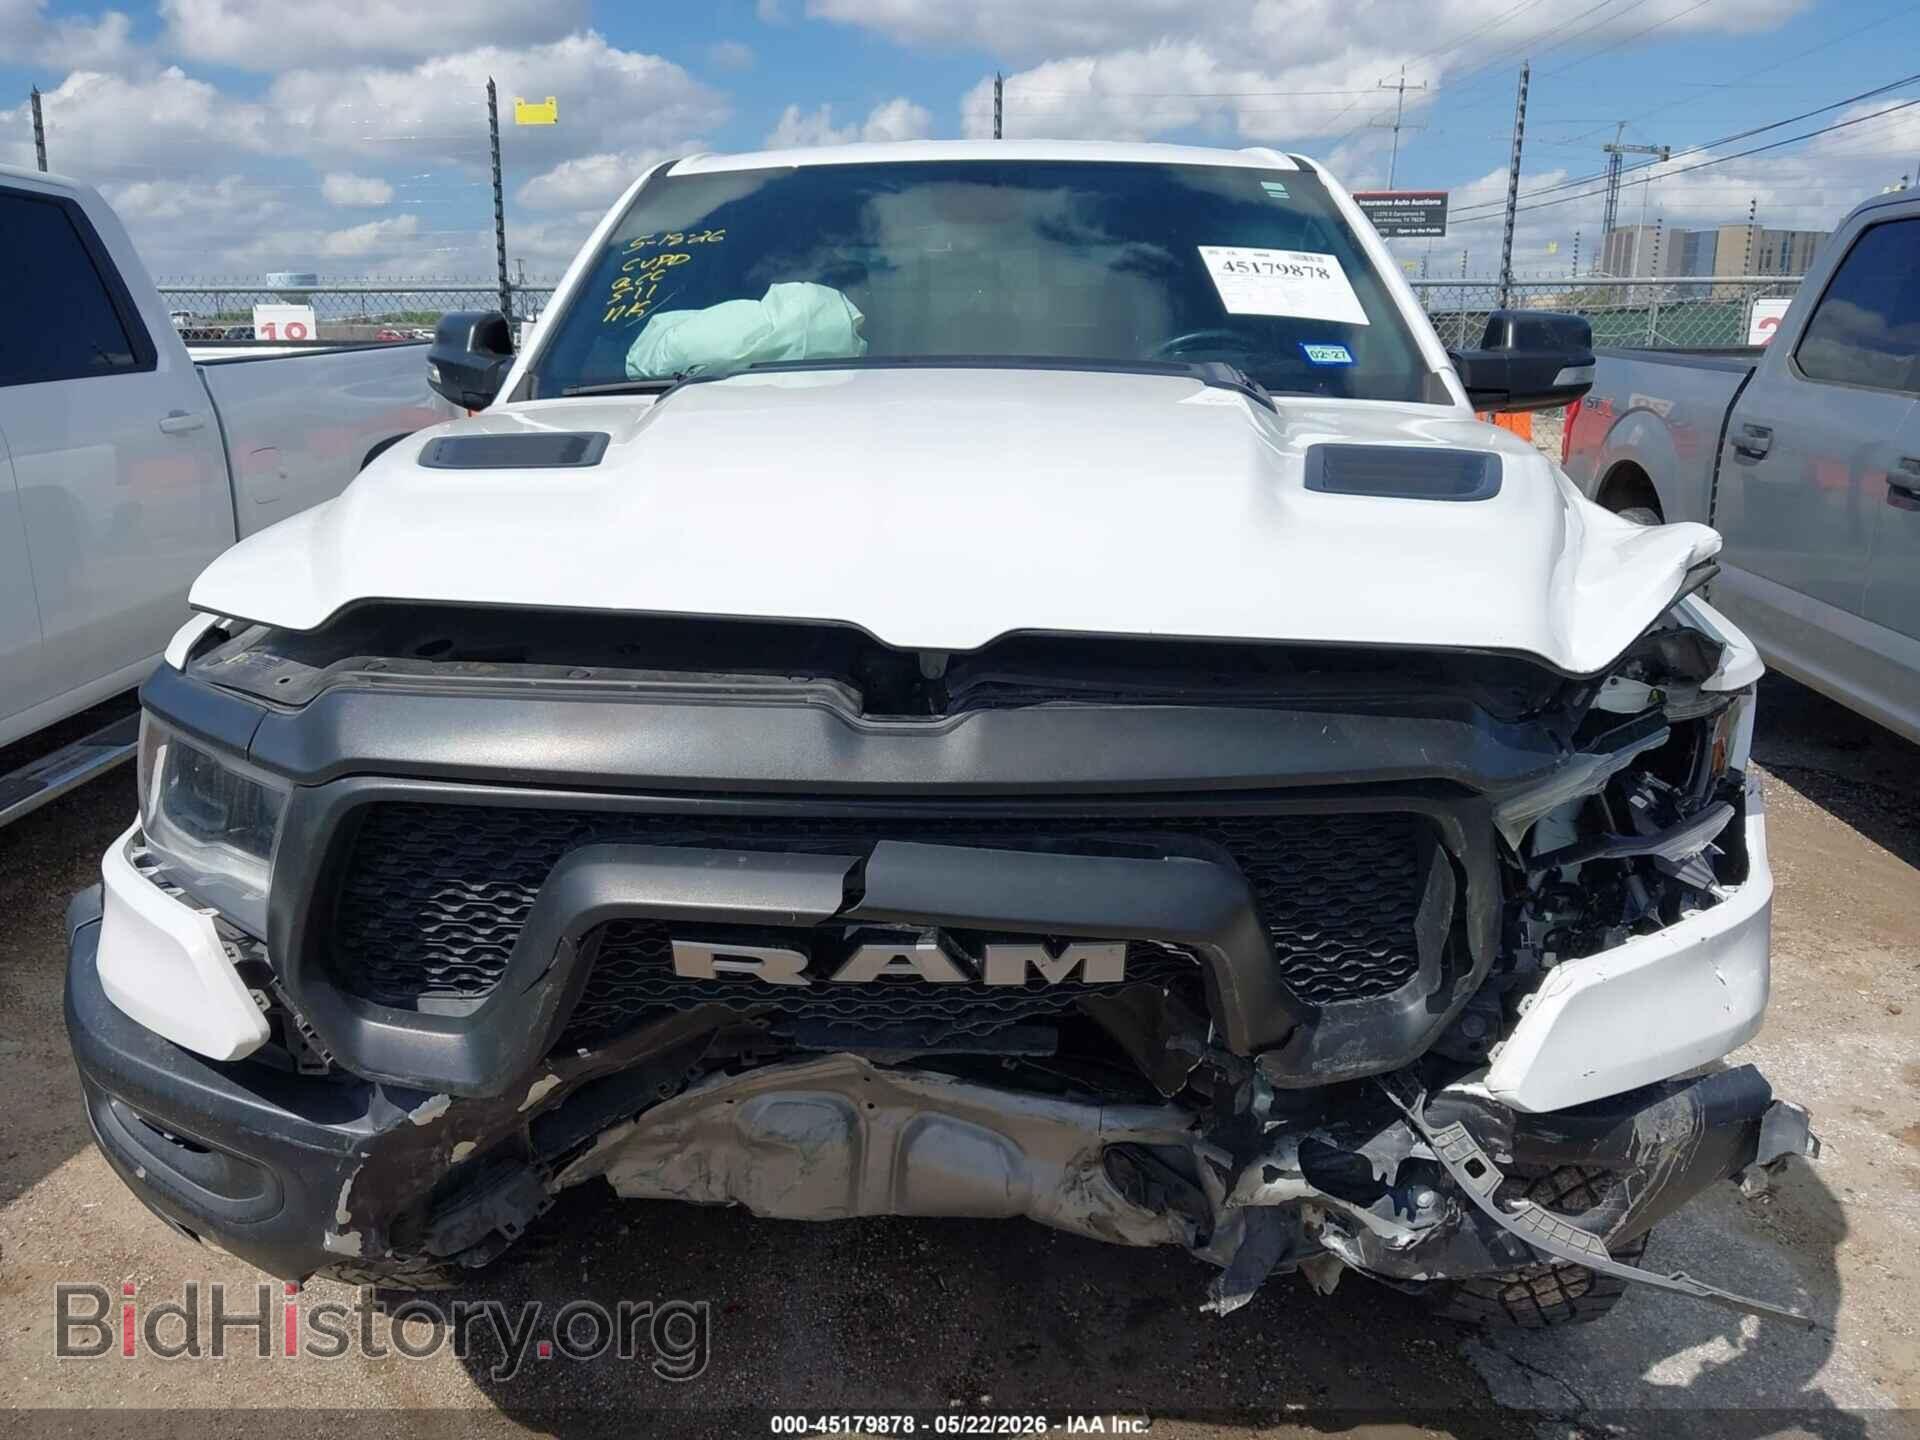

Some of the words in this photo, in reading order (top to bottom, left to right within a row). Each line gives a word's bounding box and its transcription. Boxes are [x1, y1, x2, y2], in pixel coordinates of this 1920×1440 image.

[1394, 198, 1410, 206] Auto
[1411, 198, 1442, 206] Auctions
[1222, 260, 1331, 280] 45179878
[671, 939, 1128, 986] RAM
